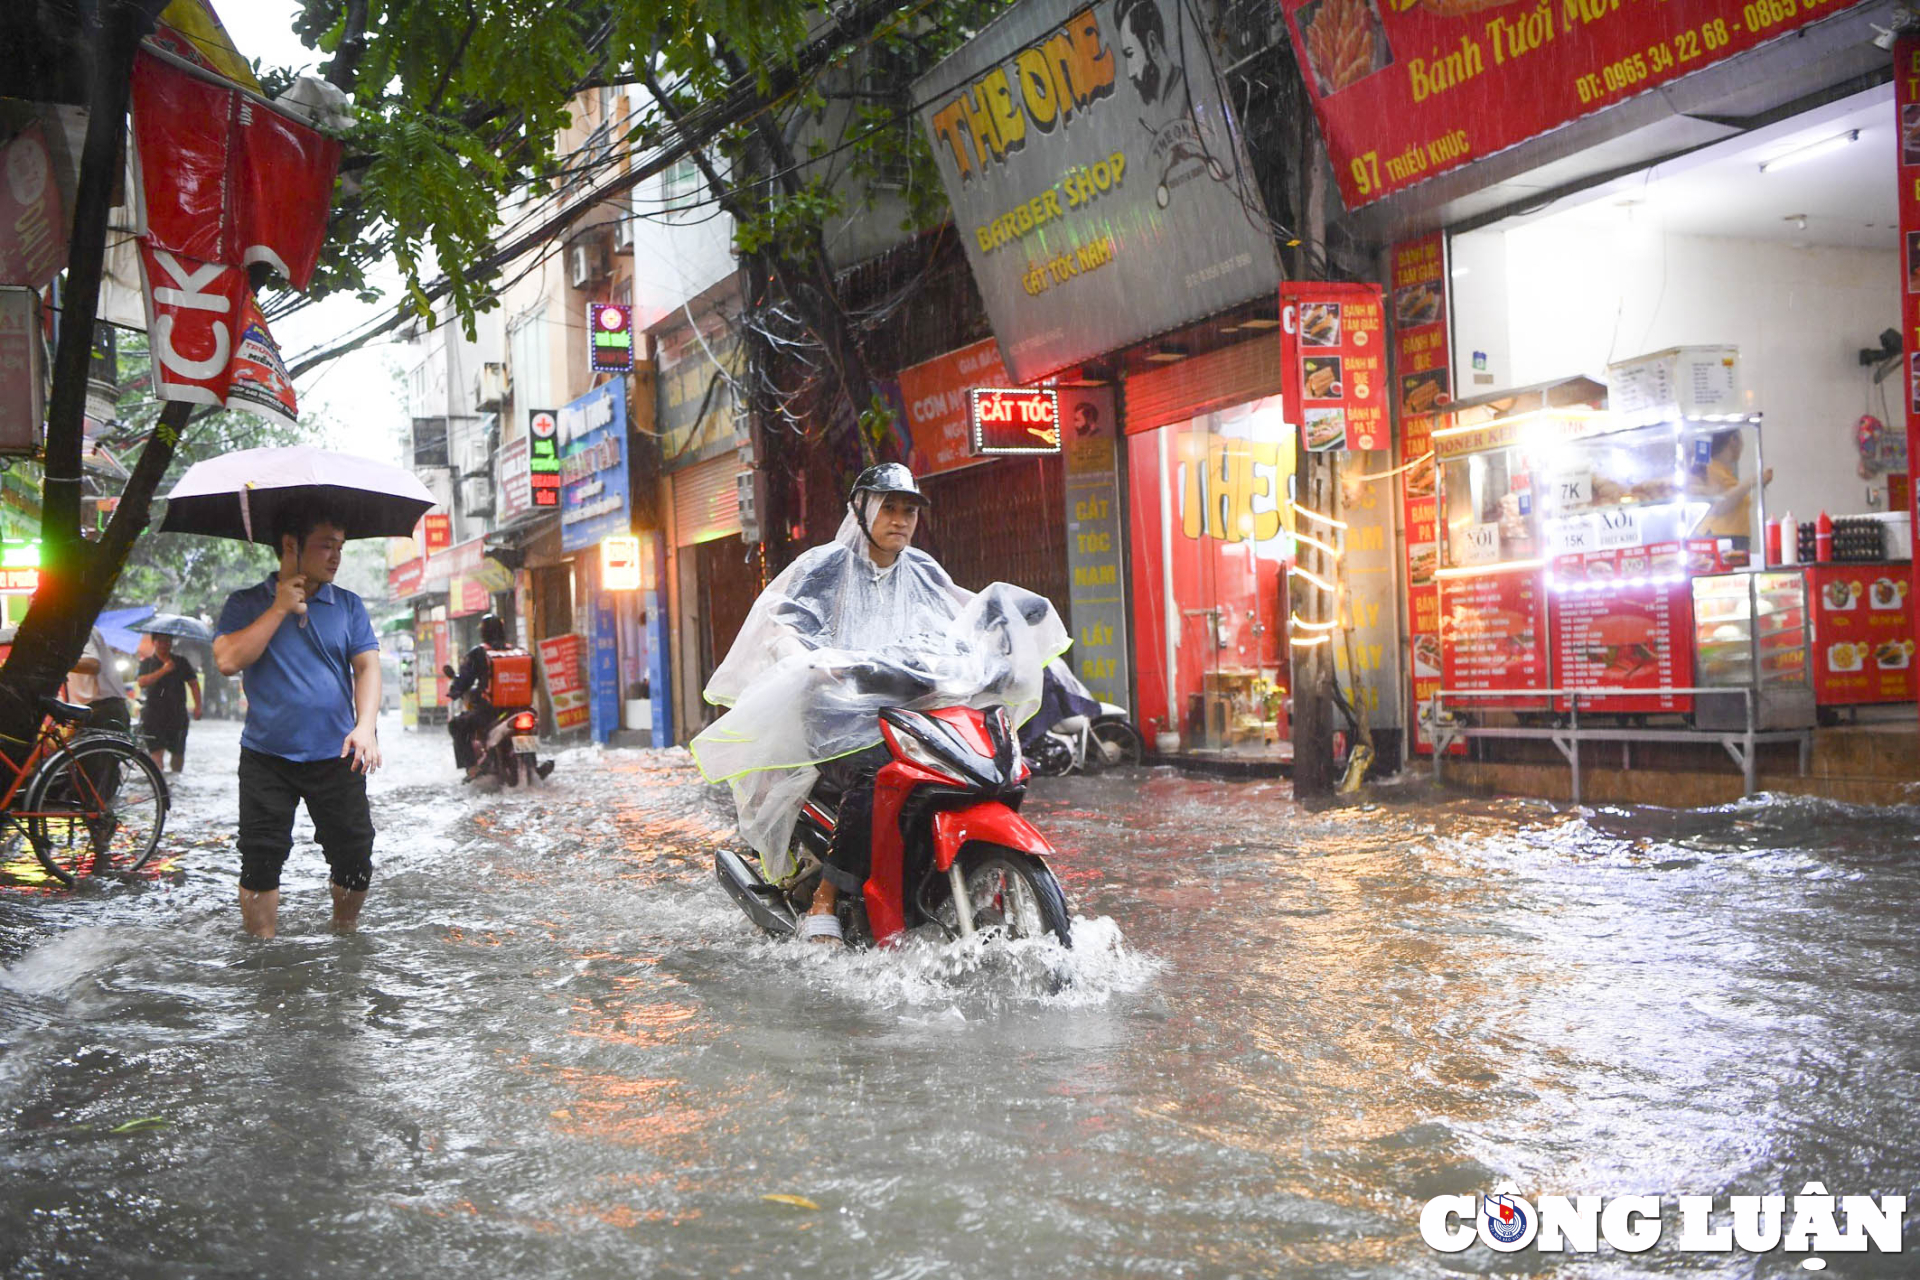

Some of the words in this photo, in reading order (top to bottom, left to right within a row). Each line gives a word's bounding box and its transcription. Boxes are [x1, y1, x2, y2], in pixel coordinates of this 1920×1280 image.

[1408, 35, 1484, 103] Bánh
[1603, 53, 1648, 92] 0965
[1649, 42, 1673, 73] 34
[1675, 30, 1701, 62] 22
[1702, 18, 1729, 50] 68
[932, 67, 1026, 180] THE
[976, 188, 1063, 253] BARBER
[1064, 152, 1126, 207] SHOP
[1351, 151, 1382, 195] 97
[1048, 251, 1077, 285] TÓC
[1076, 235, 1113, 273] NAM
[980, 391, 1014, 421] CẮT
[1017, 394, 1053, 421] TÓC
[1561, 482, 1581, 500] 7K
